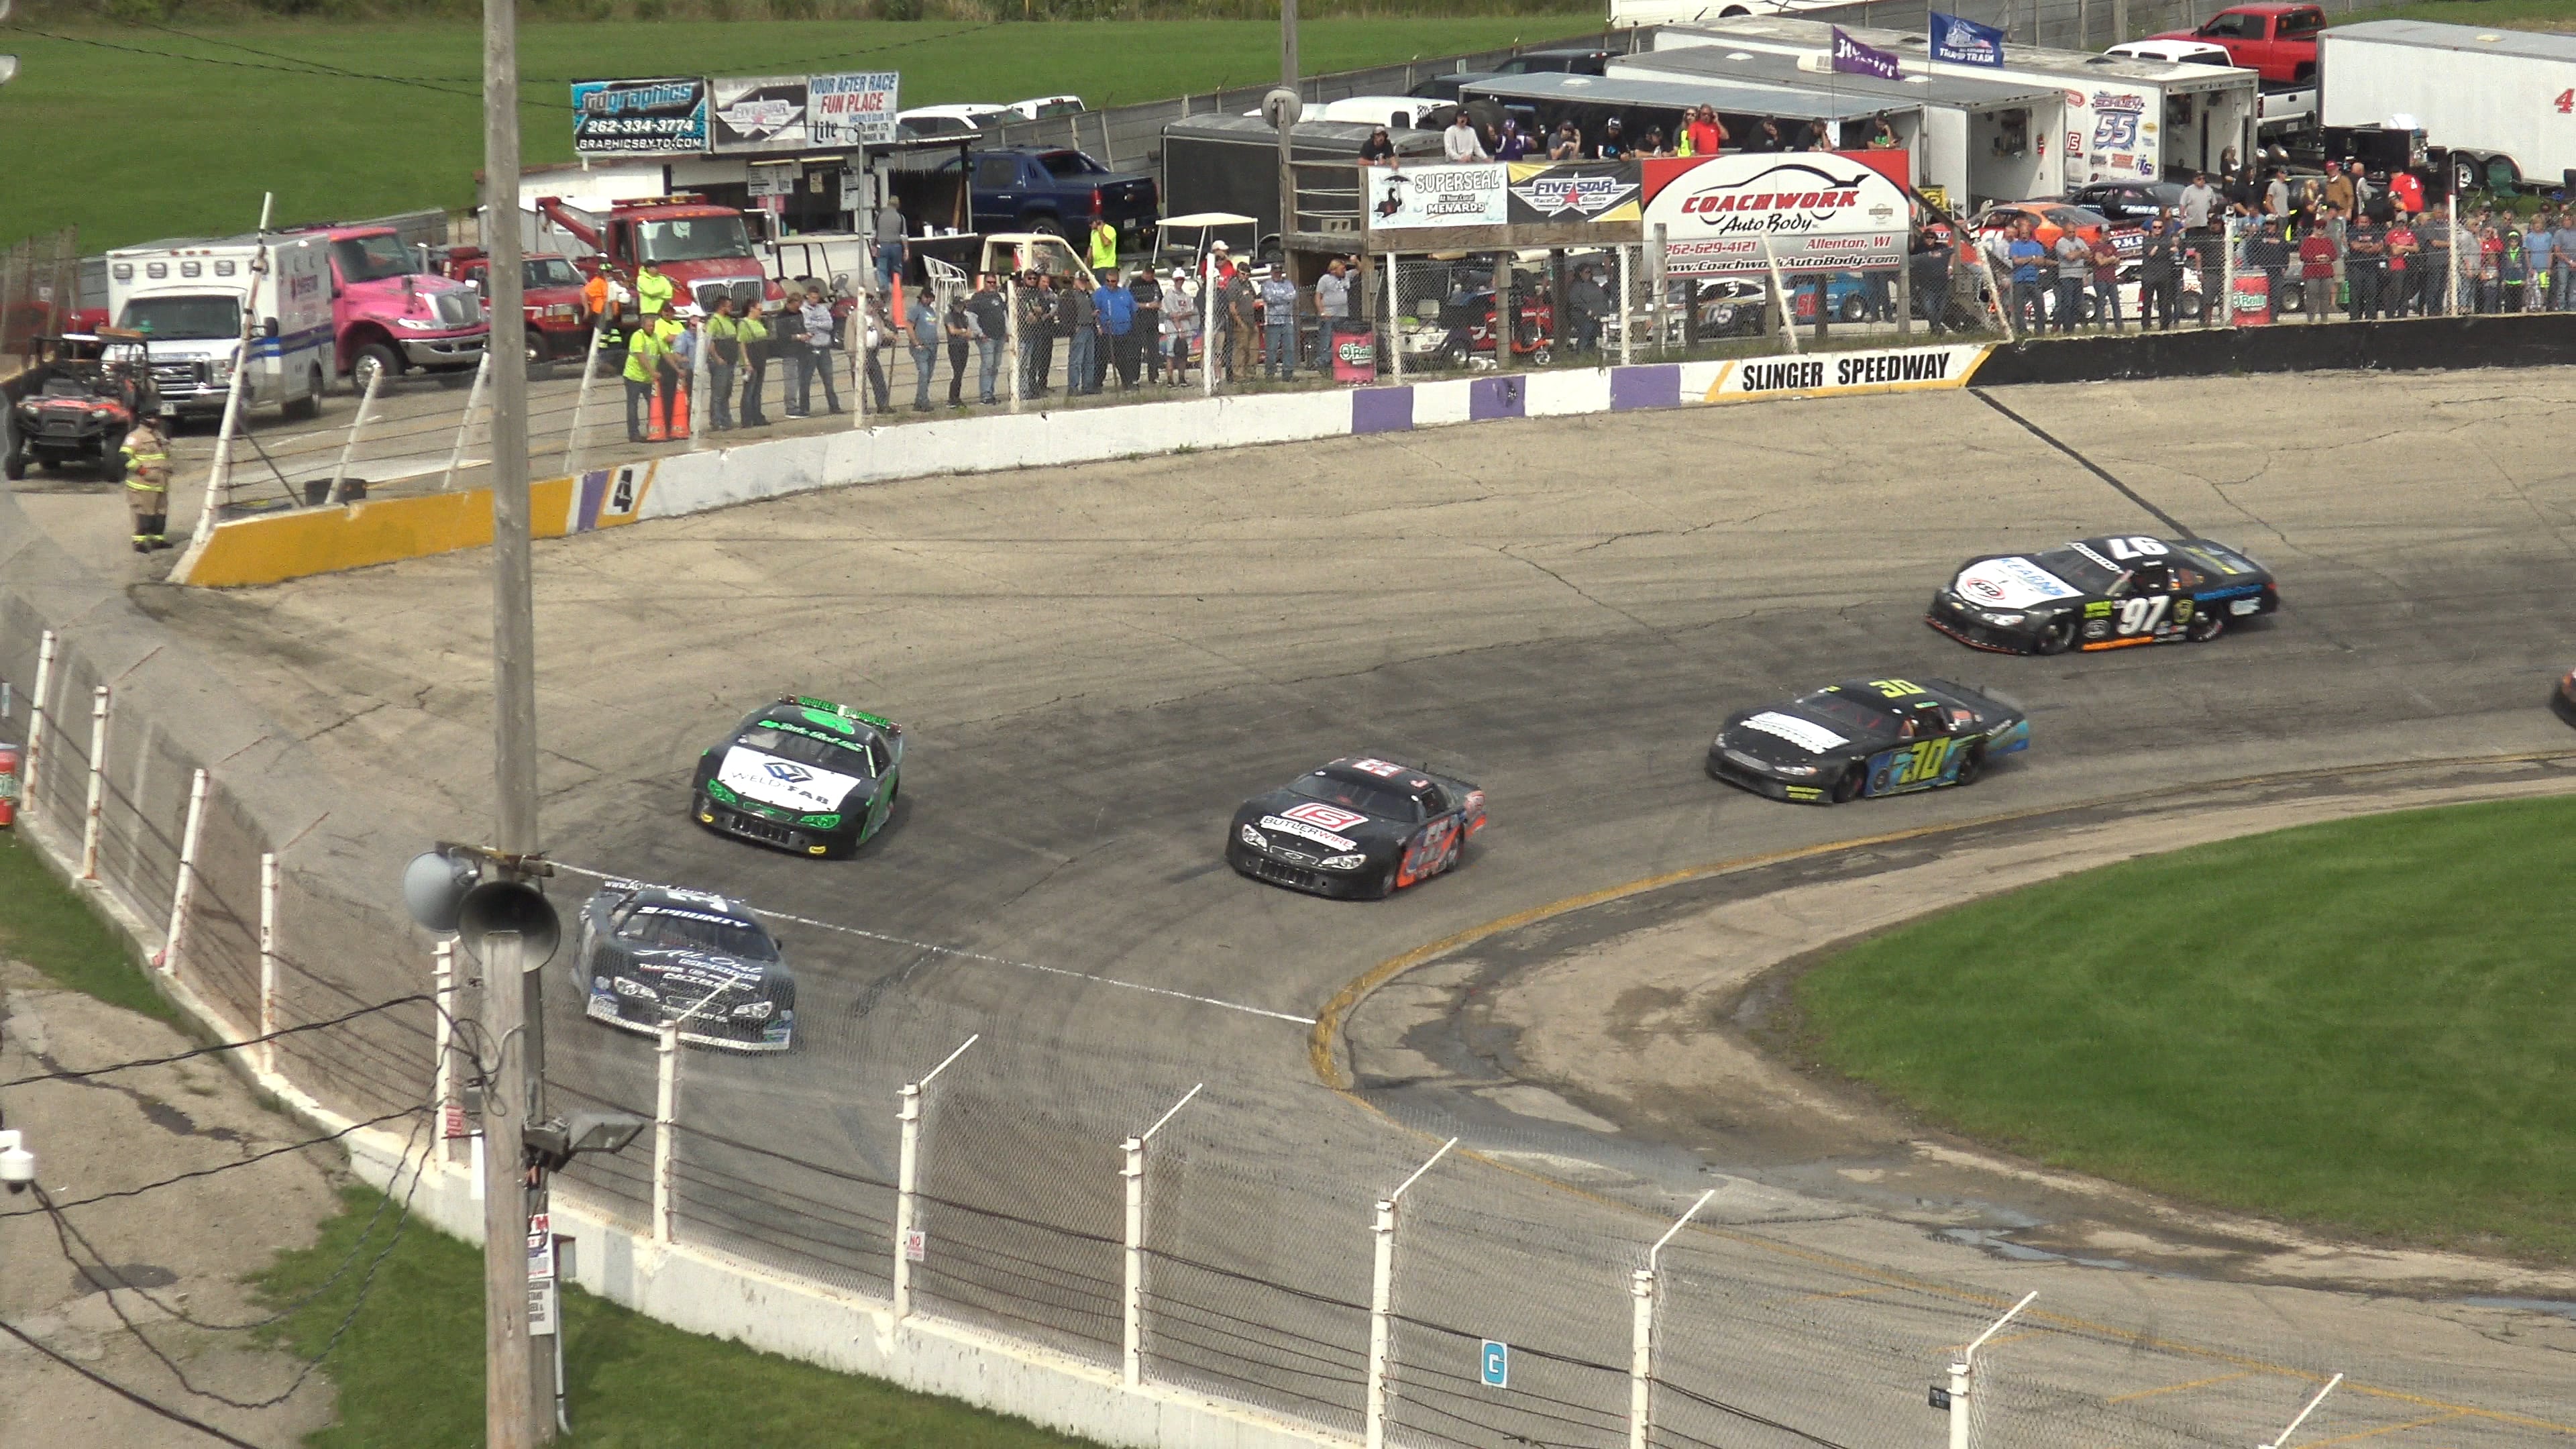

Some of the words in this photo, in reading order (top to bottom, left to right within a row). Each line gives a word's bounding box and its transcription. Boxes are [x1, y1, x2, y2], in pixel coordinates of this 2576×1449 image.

[810, 78, 836, 95] YOUR
[837, 76, 866, 93] AFTER
[869, 74, 896, 91] RACE
[820, 95, 845, 114] FUN
[847, 93, 884, 112] PLACE
[588, 119, 695, 133] 262-334-3774
[813, 121, 838, 144] Lite
[2094, 115, 2133, 146] 55
[1415, 170, 1500, 193] SUPERSEAL
[1534, 182, 1572, 195] FIVE
[1577, 181, 1613, 194] STAR
[1428, 203, 1486, 215] MENARDS
[1681, 191, 1860, 213] COACHWORK
[1719, 215, 1764, 235] Auto
[1766, 213, 1814, 234] Body
[1666, 241, 1757, 255] 262-629-4121
[1806, 237, 1868, 250] Allenton,
[1874, 235, 1891, 247] WI
[1743, 362, 1824, 391] SLINGER
[1838, 352, 1951, 385] SPEEDWAY
[612, 469, 633, 513] 4
[2116, 595, 2170, 635] 97
[1484, 1343, 1505, 1384] G
